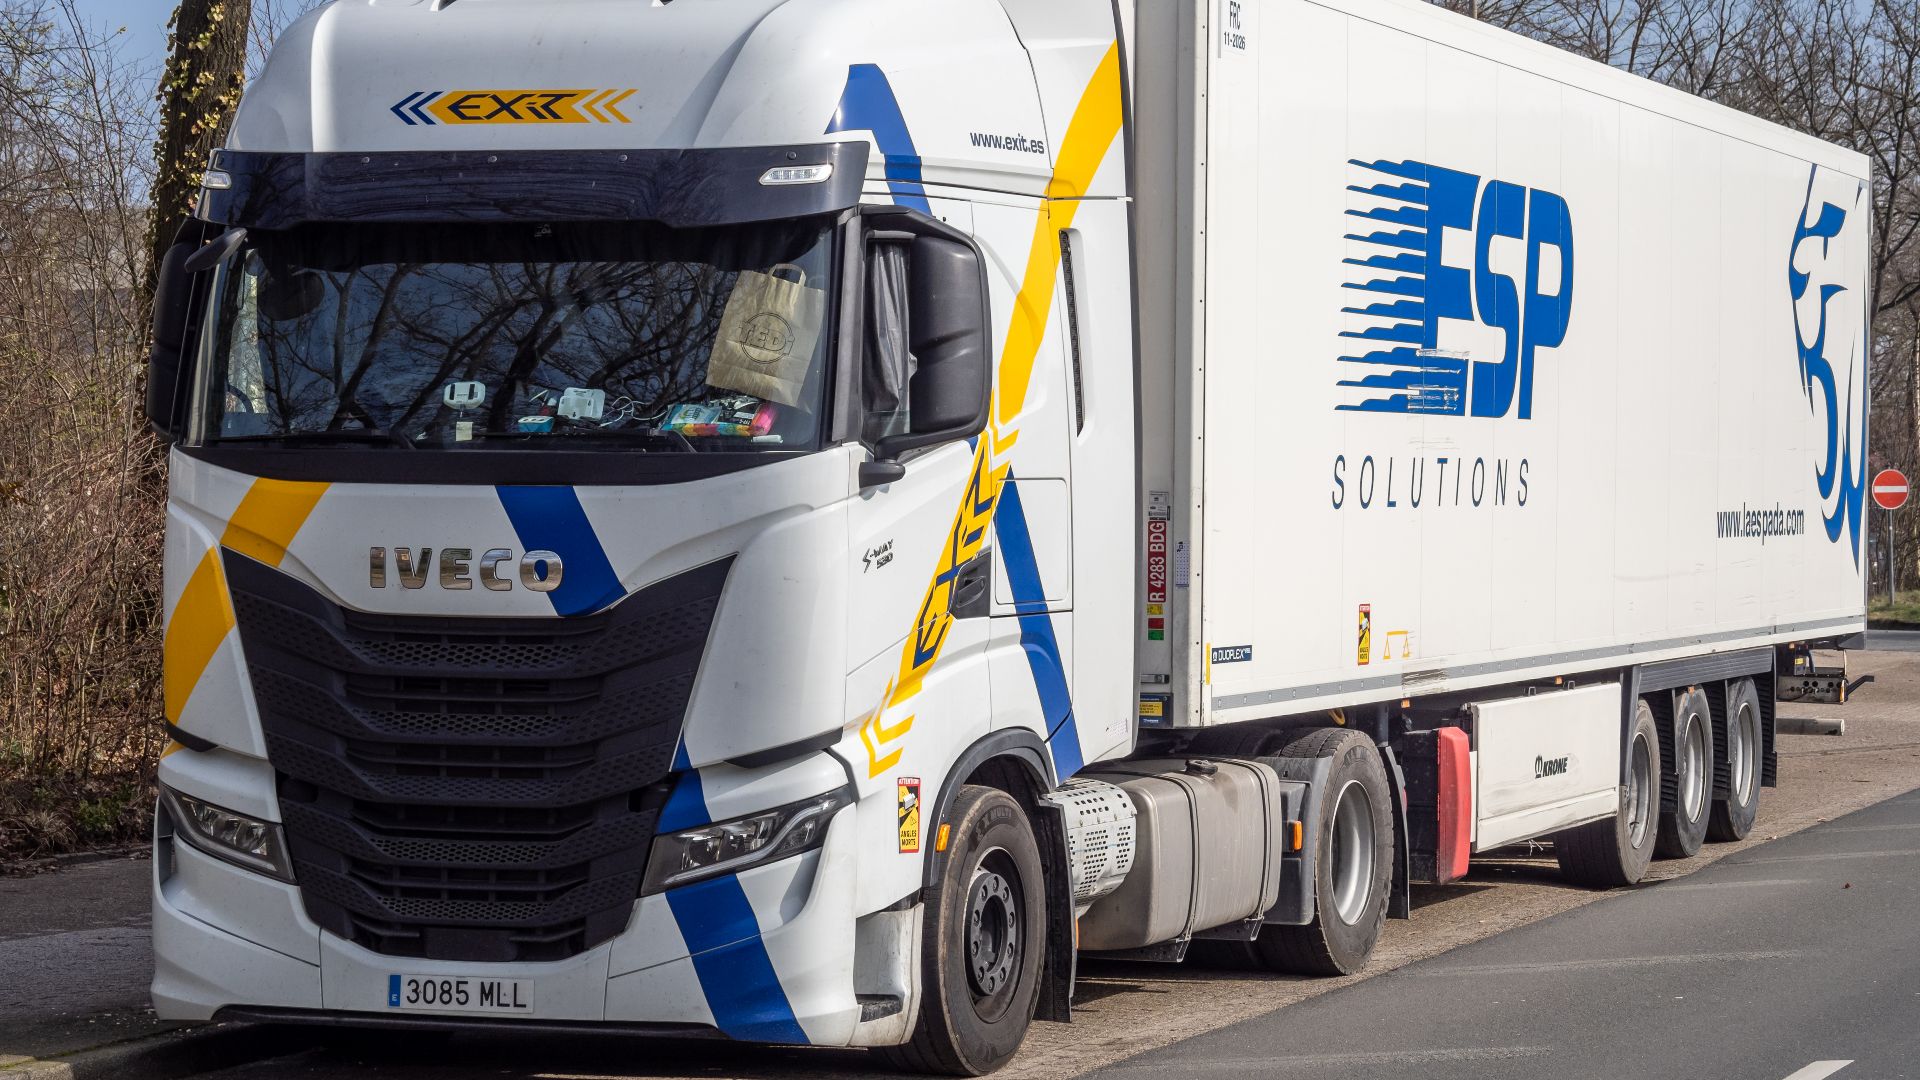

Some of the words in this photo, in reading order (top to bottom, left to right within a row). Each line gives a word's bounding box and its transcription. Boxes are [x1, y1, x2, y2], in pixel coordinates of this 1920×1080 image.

[1229, 0, 1241, 30] FRC
[1223, 31, 1246, 50] 11-2026
[969, 132, 1045, 155] www.exit.es
[1334, 158, 1574, 420] ESP
[1331, 454, 1530, 510] SOLUTIONS
[1149, 522, 1166, 552] BDG
[1716, 501, 1806, 546] www.laespada.com
[368, 546, 564, 593] IVECO
[1149, 556, 1166, 588] 4283
[1149, 592, 1166, 602] R
[1542, 757, 1568, 777] KRONE
[406, 978, 470, 1006] 3085
[479, 981, 527, 1009] MLL
